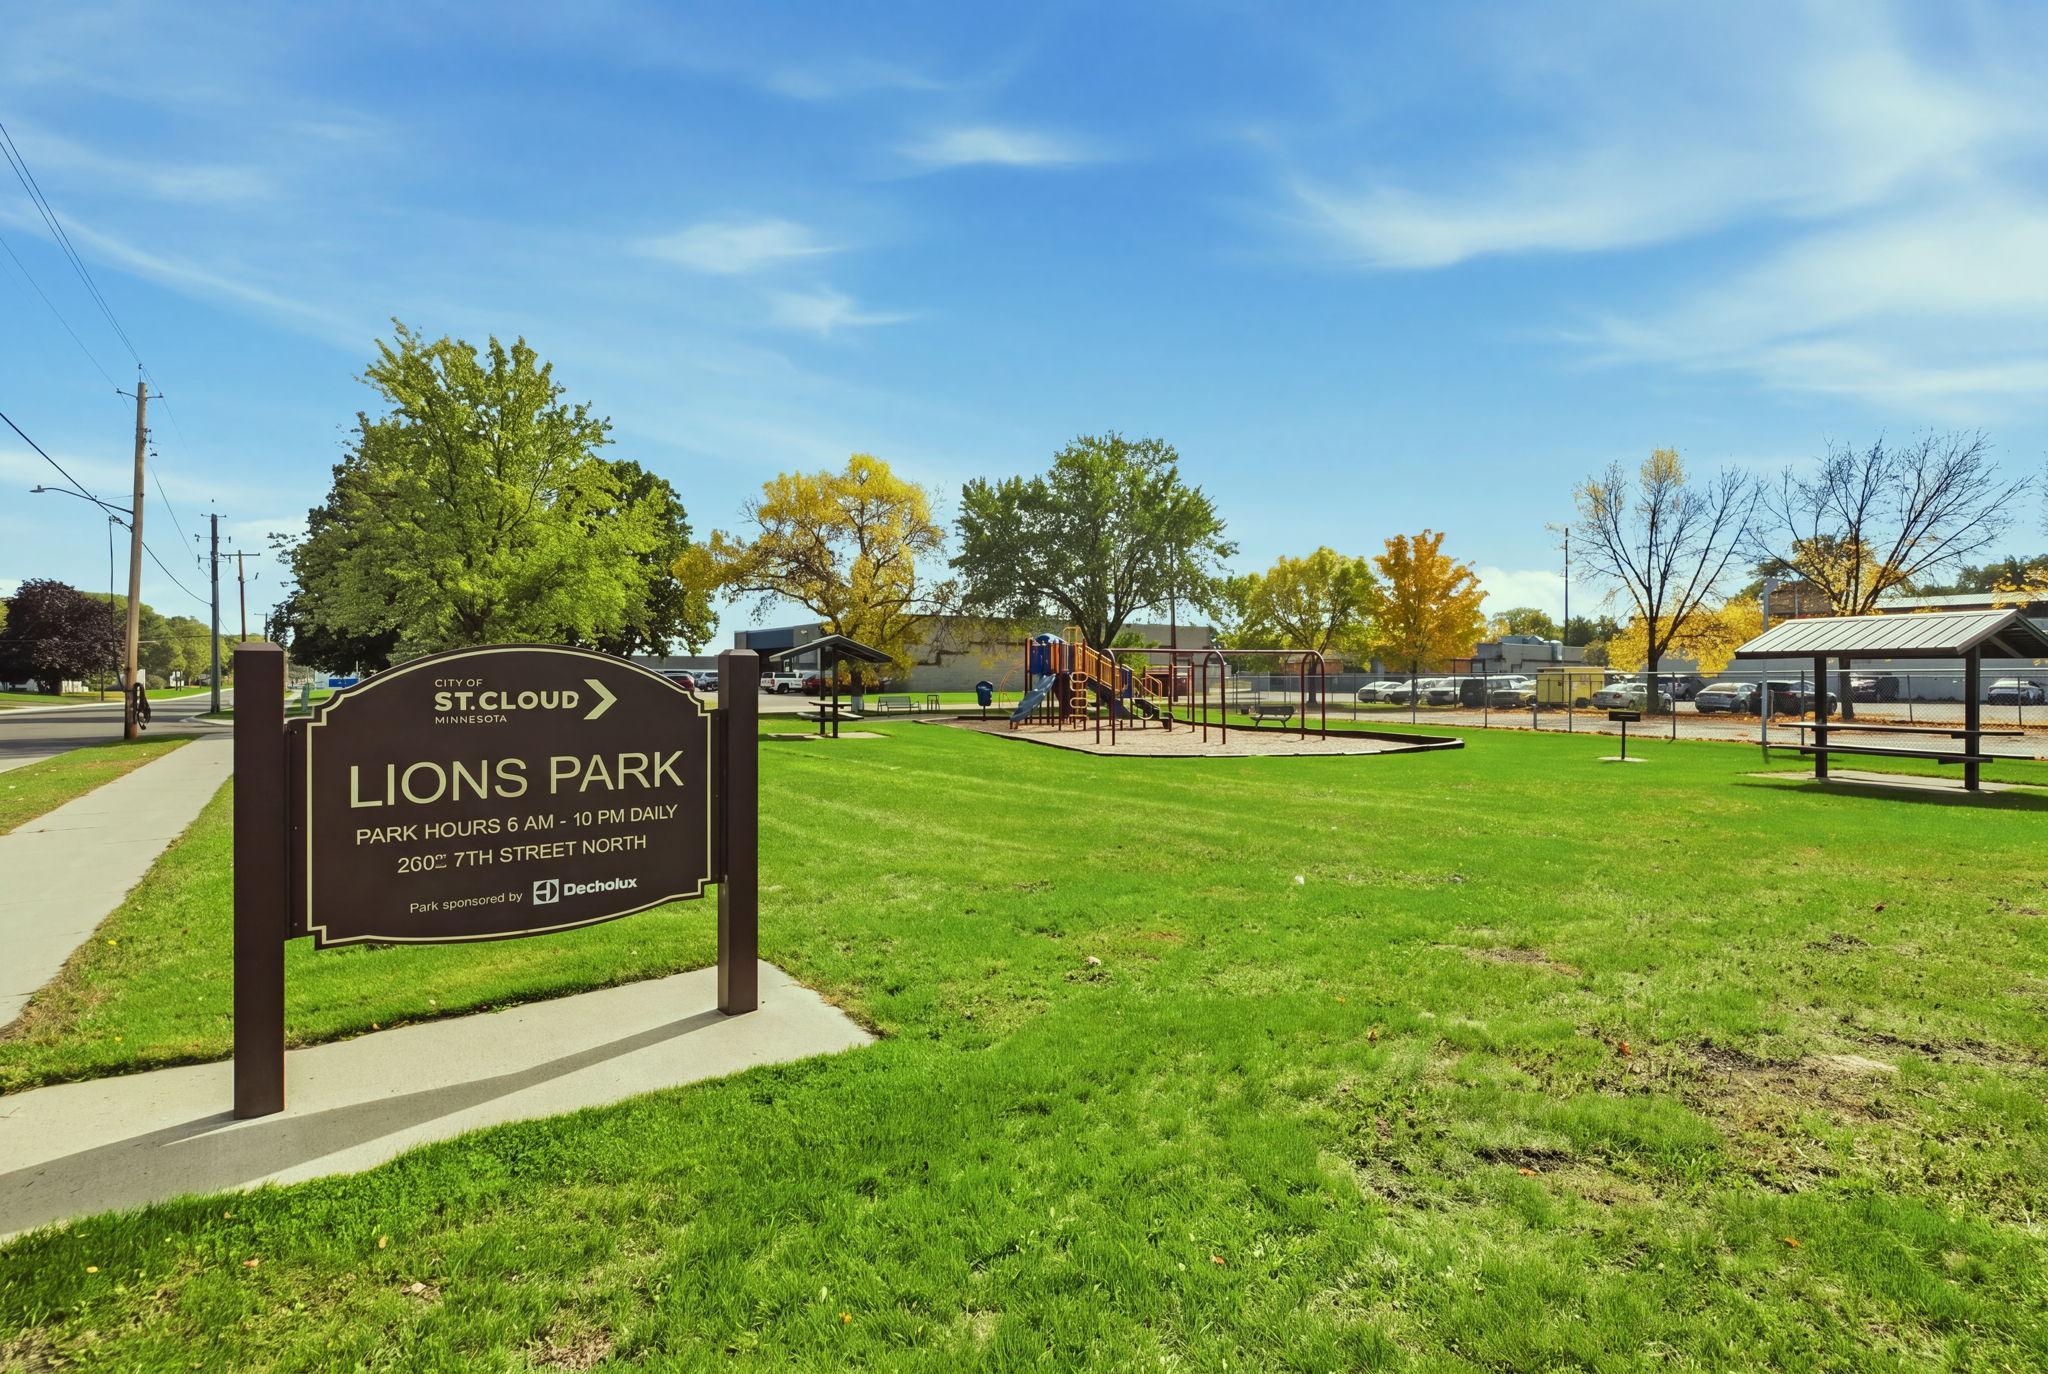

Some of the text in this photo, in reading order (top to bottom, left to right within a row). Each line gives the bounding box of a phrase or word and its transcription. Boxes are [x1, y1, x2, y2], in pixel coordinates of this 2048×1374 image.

[434, 678, 483, 688] CITY OF
[434, 690, 580, 712] ST.CLOUD
[435, 714, 507, 725] MINNESOTA
[350, 750, 685, 809] LIONS PARK
[356, 824, 418, 846] PARK
[425, 818, 501, 840] HOURS
[507, 816, 519, 833] 6
[523, 814, 554, 831] AM
[573, 811, 592, 827] 10
[598, 808, 625, 825] PM
[630, 803, 678, 822] DAILY
[453, 849, 493, 868] 7TH
[499, 840, 577, 863] STREET
[582, 834, 647, 855] NORTH
[409, 877, 638, 914] Park sponsored by Decholux
